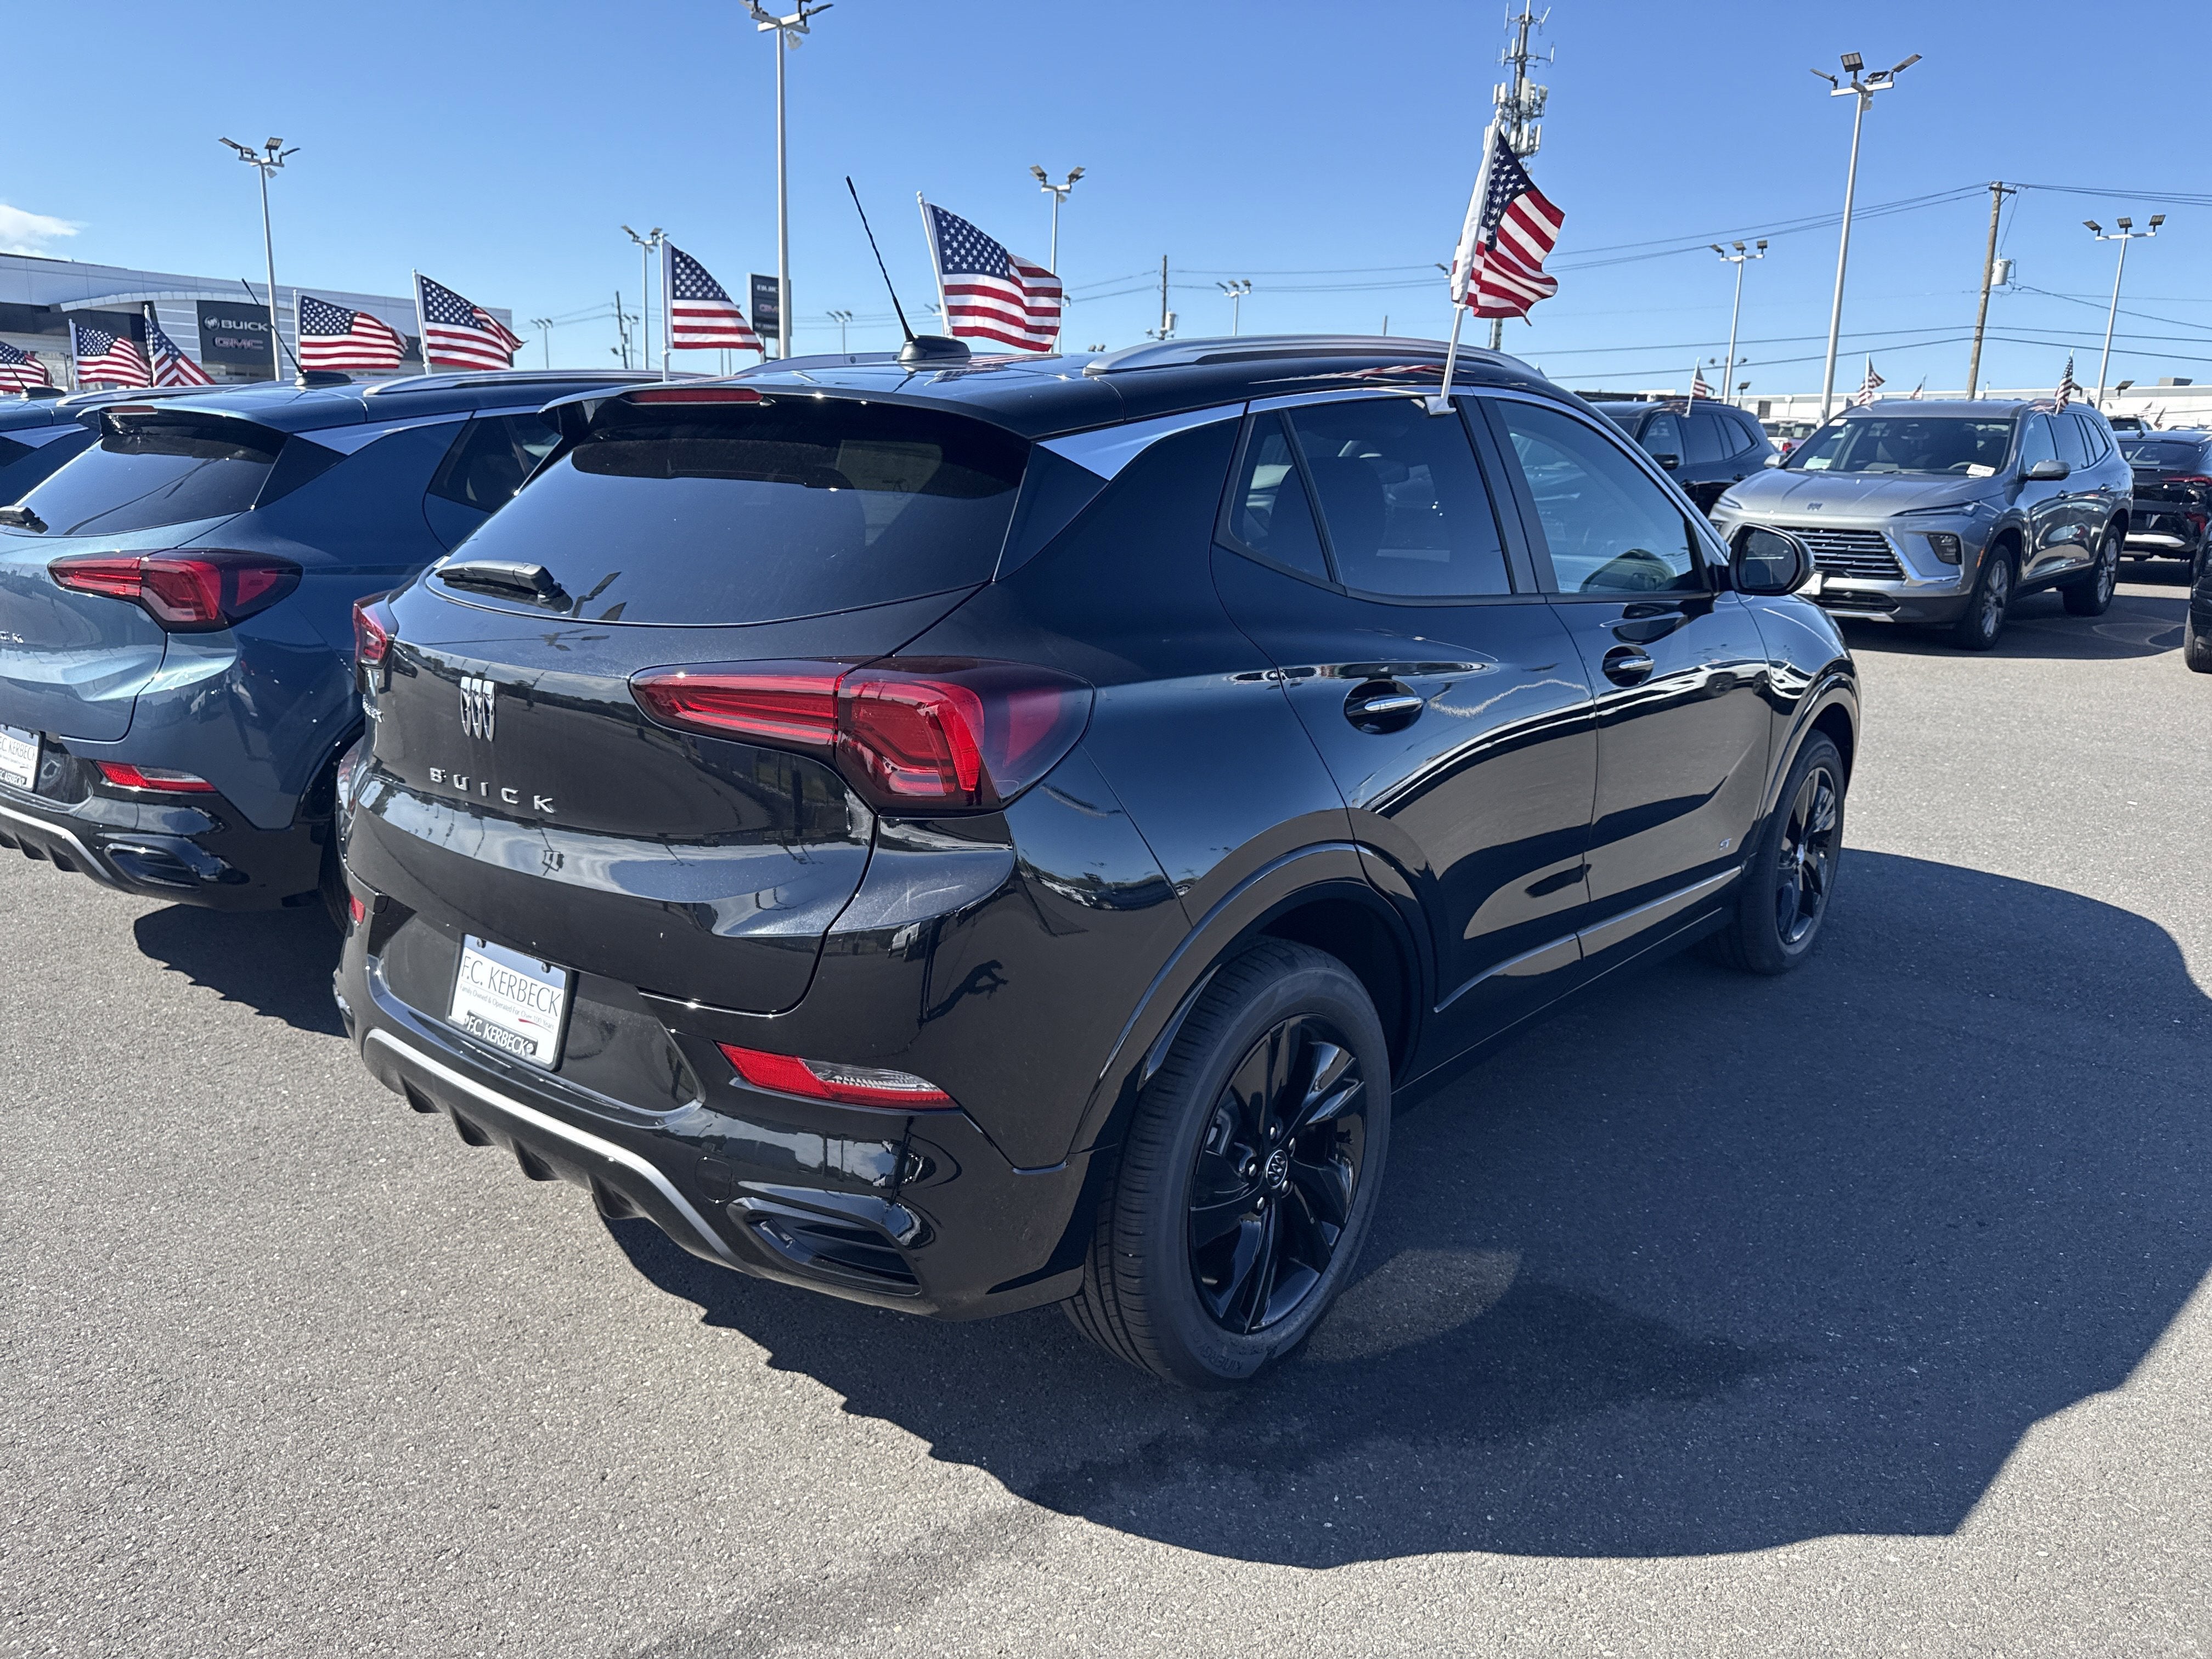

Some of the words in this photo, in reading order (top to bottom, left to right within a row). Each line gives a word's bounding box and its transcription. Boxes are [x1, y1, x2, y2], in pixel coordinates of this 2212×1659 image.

[215, 337, 264, 350] GMC
[221, 319, 268, 332] BUICK
[430, 767, 556, 814] BUICK
[460, 955, 483, 986] F.C.
[488, 967, 562, 1017] KERBECK
[472, 990, 488, 1002] Owned
[492, 998, 512, 1013] Operated
[521, 1010, 532, 1019] Over
[533, 1014, 543, 1024] 100
[543, 1019, 555, 1031] Years
[483, 1023, 527, 1056] KERBECK
